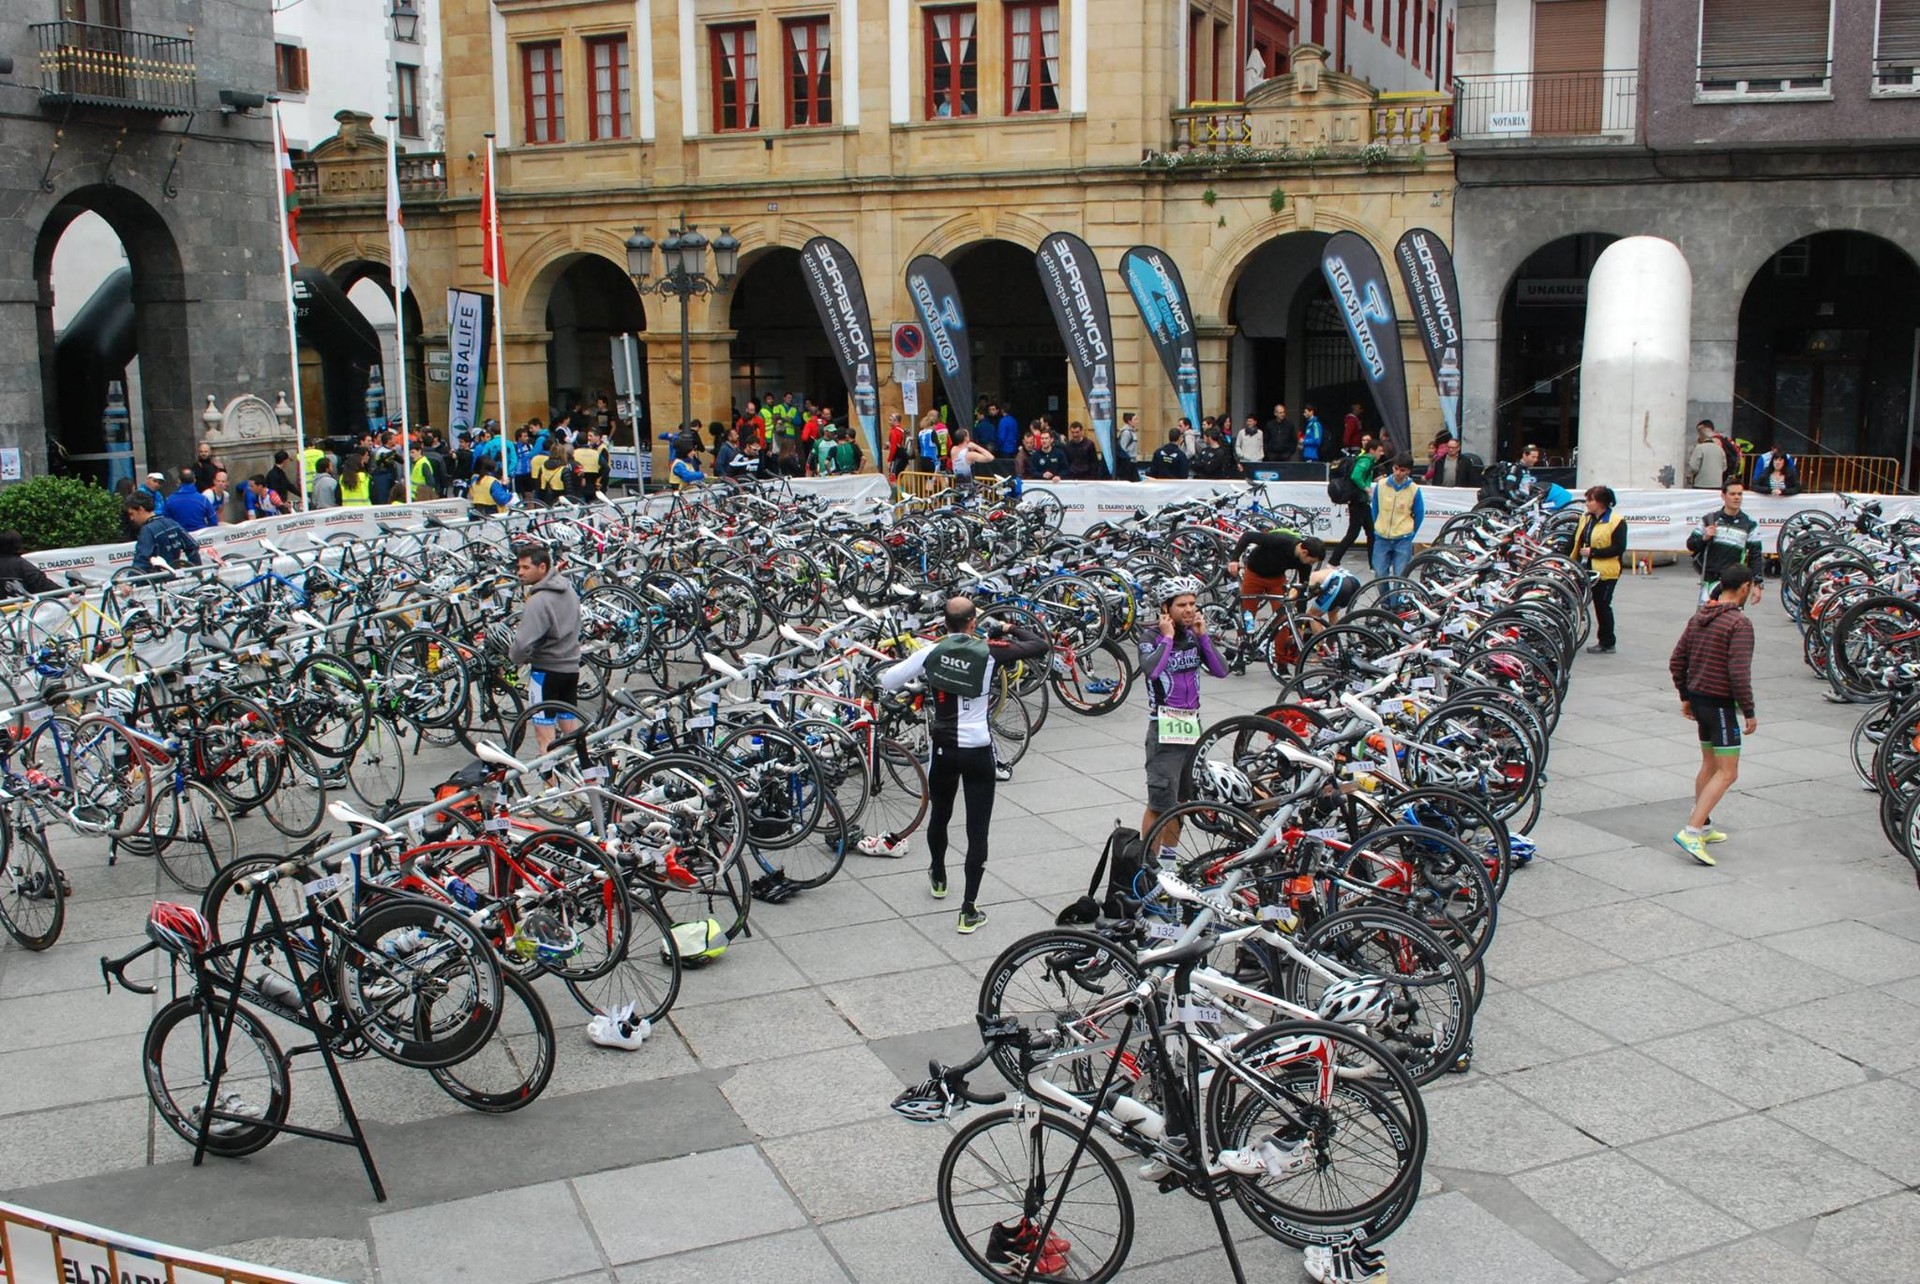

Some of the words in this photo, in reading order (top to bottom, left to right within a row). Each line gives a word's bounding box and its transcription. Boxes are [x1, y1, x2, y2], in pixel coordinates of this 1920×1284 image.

[1492, 116, 1526, 126] NOTARIA
[1259, 116, 1360, 145] MERCADO
[323, 169, 387, 191] MERCADO
[1527, 284, 1585, 295] UNANUE
[456, 306, 474, 413] HERBALIFE
[610, 460, 651, 471] RBALFE
[47, 559, 72, 569] DIARIO
[73, 556, 95, 566] VASCO
[940, 655, 971, 670] DKV
[1166, 721, 1193, 734] 110
[317, 877, 336, 890] 078
[1156, 926, 1175, 937] 132
[1199, 1010, 1217, 1020] 114
